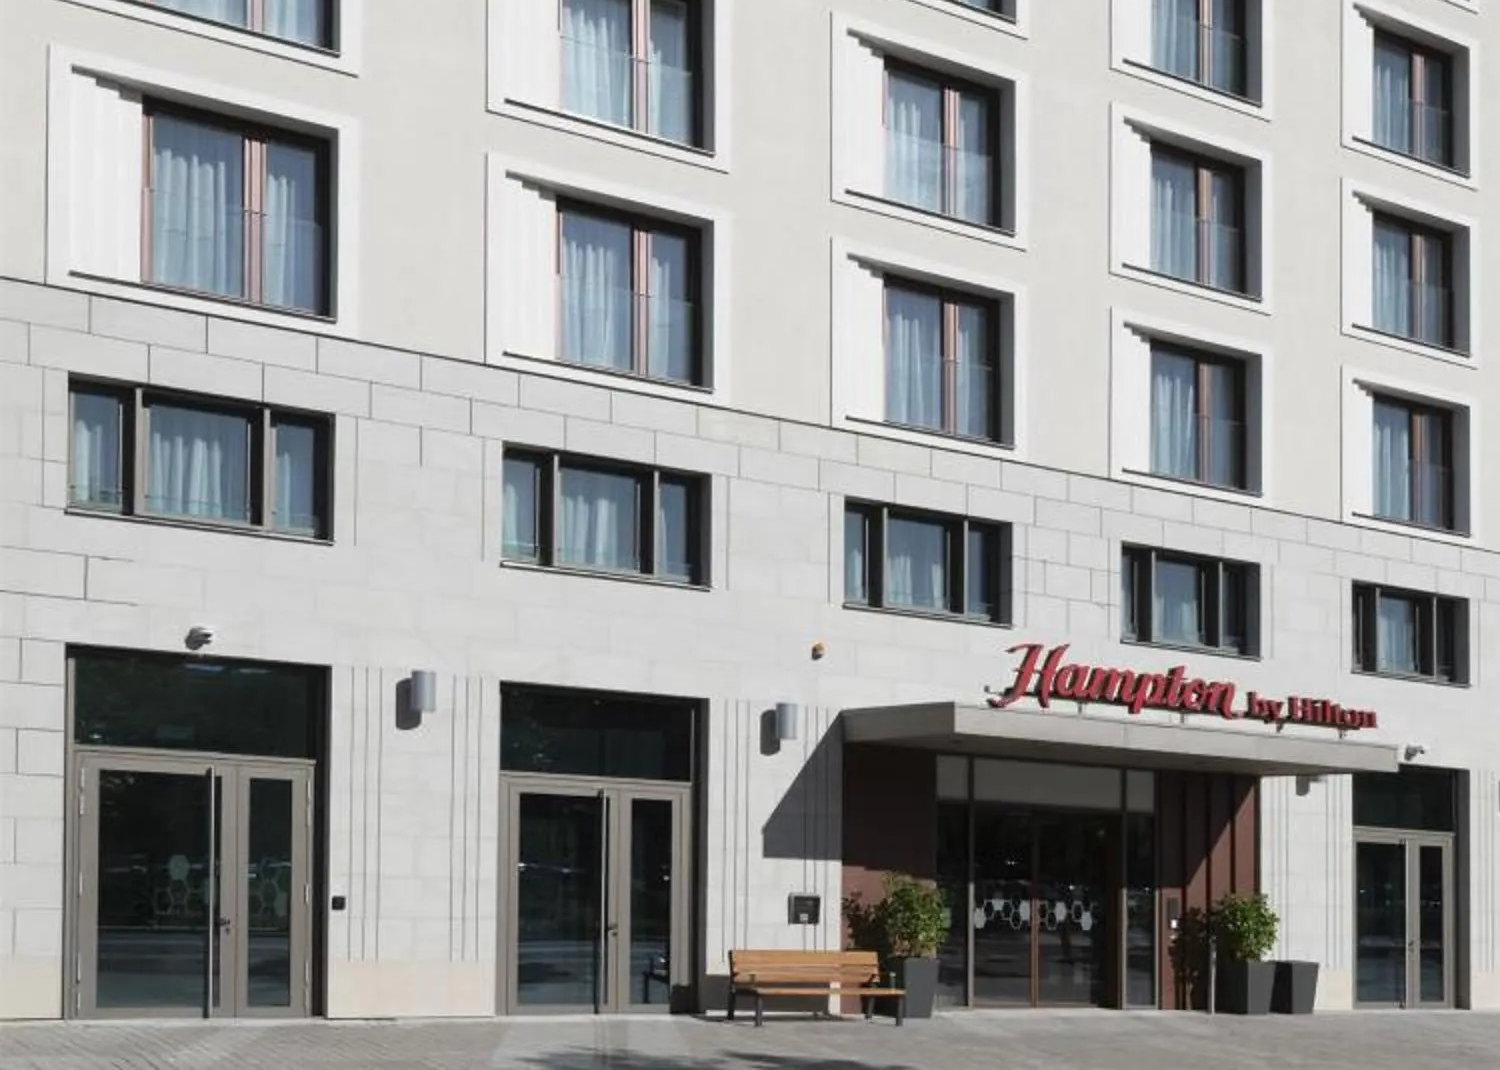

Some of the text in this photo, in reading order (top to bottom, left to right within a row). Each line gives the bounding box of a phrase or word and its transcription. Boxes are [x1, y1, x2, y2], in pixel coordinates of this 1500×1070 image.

[986, 643, 1377, 728] Hampton by Hilton
